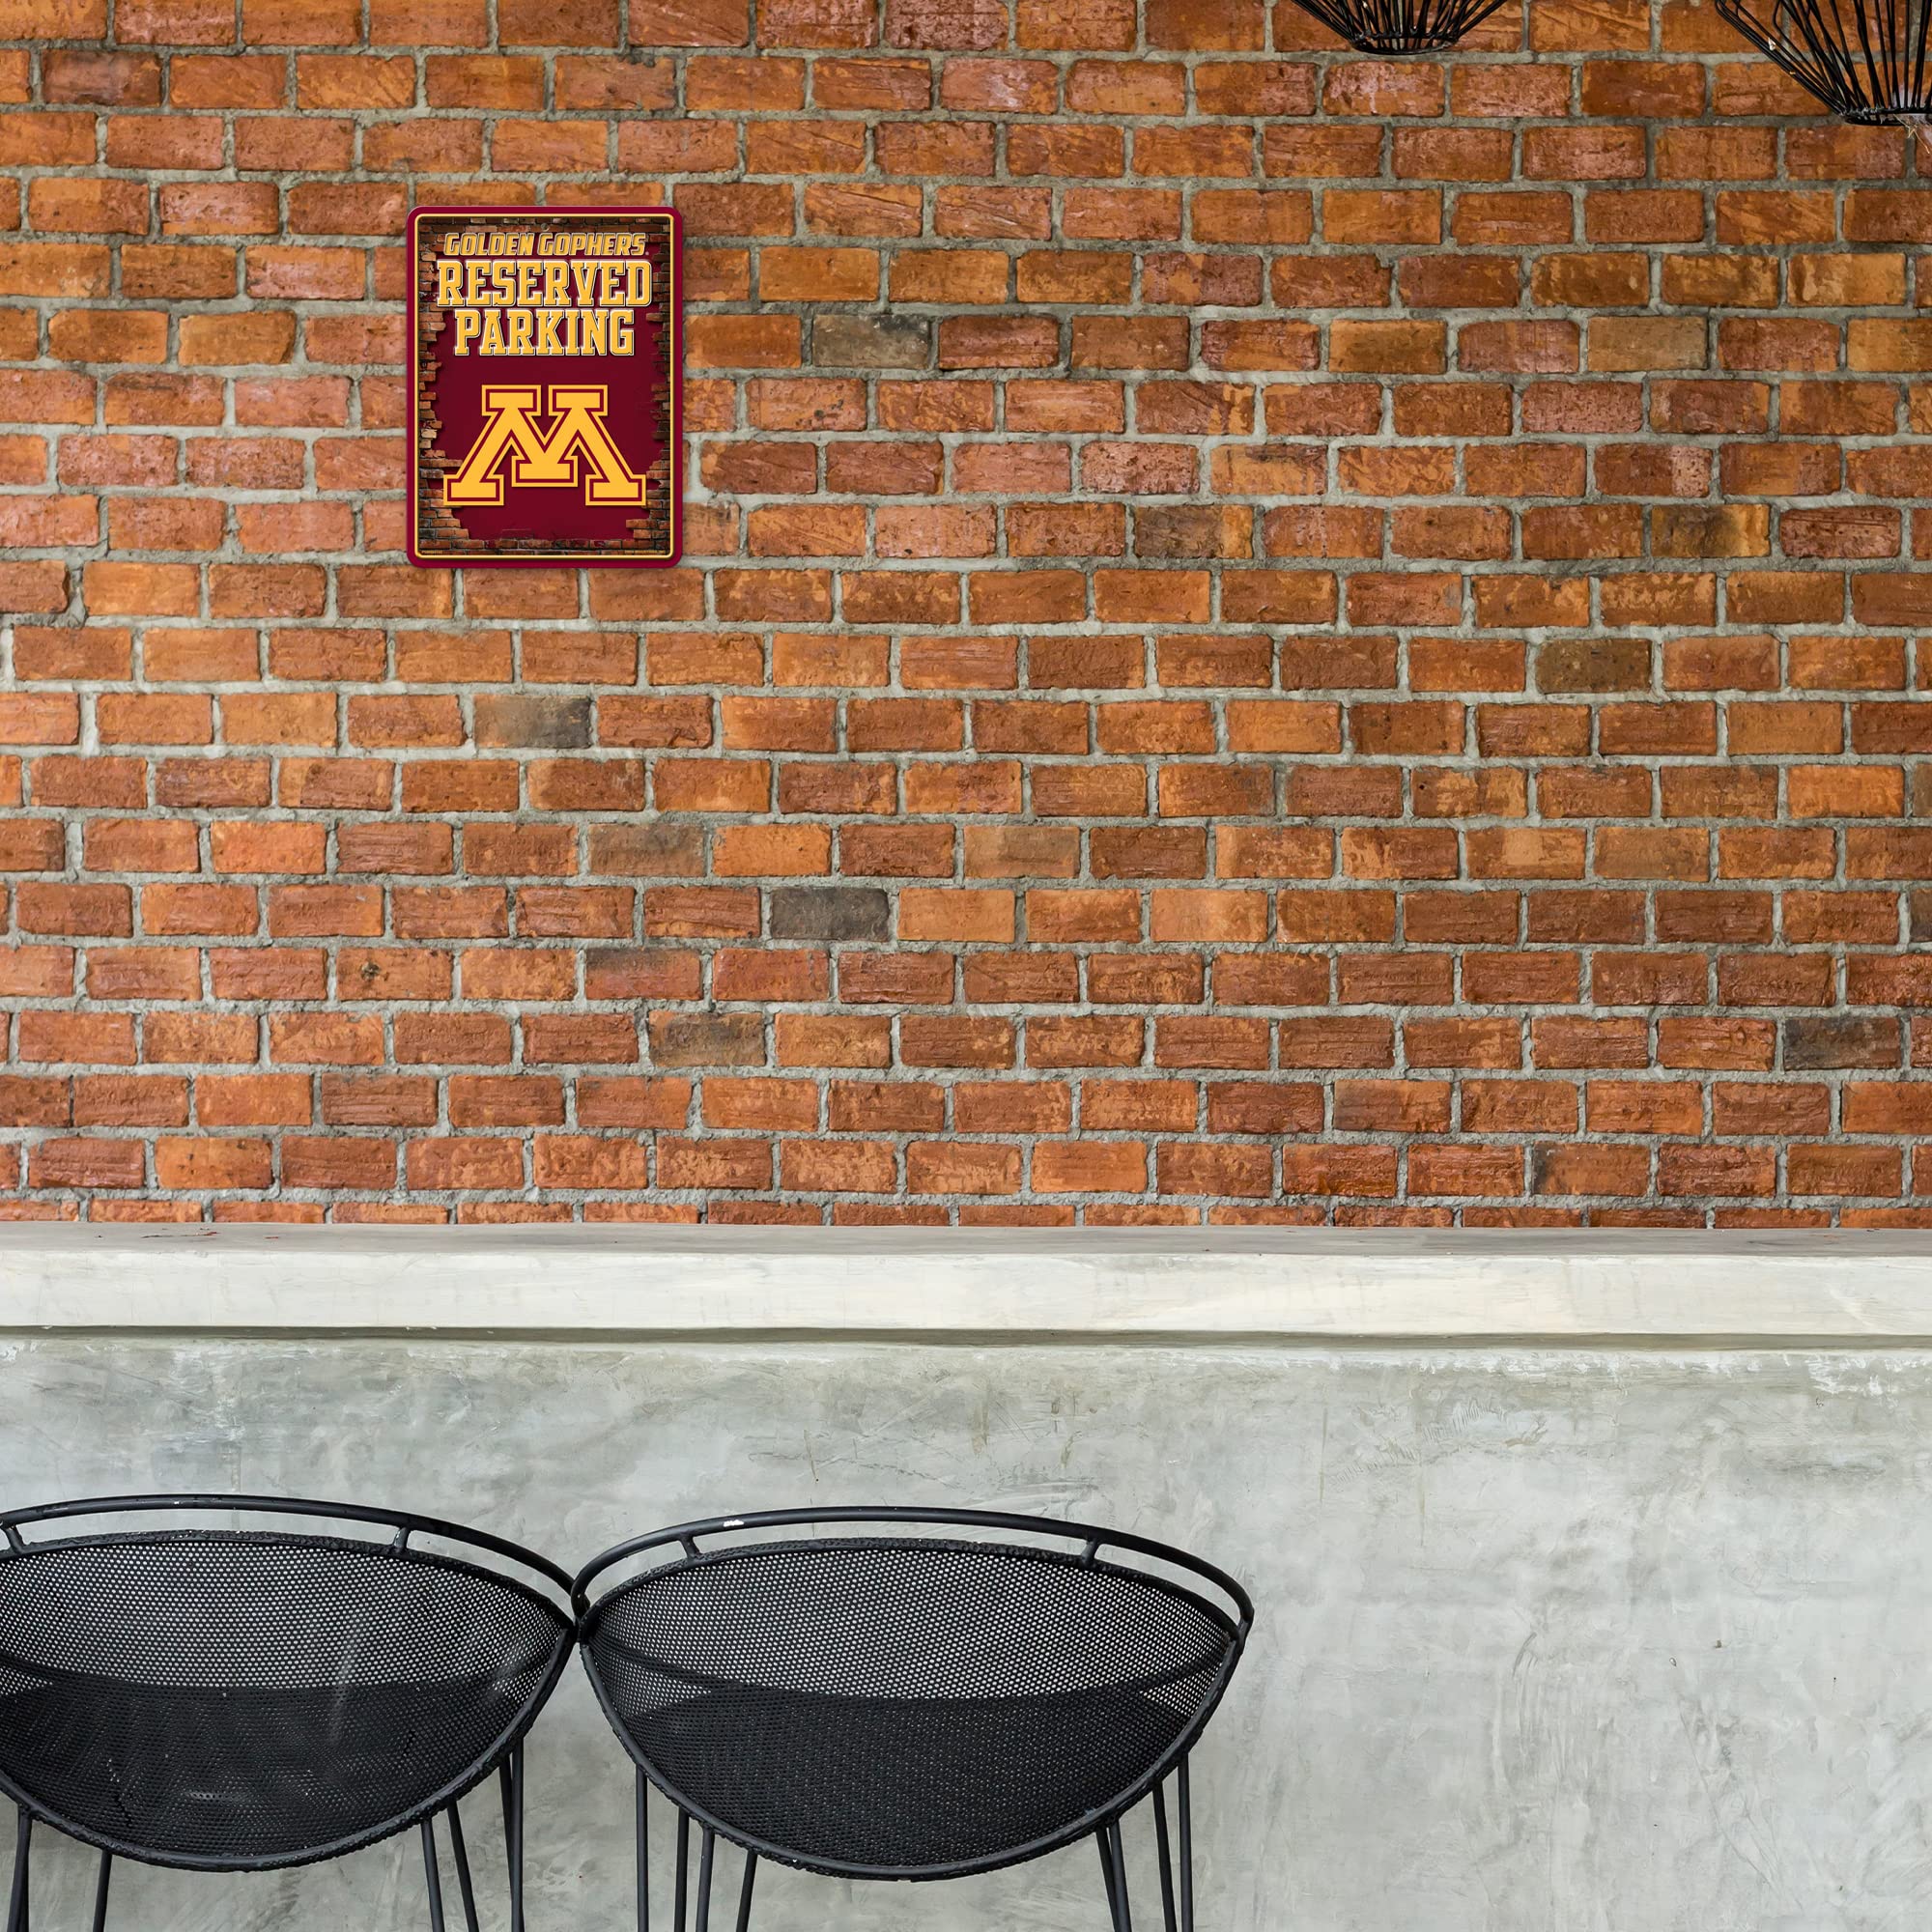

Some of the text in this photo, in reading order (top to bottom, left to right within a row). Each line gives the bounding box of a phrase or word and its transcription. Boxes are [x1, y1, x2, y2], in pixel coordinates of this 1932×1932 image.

[443, 232, 647, 256] GOLDEN GOPHERS
[437, 260, 652, 307] RESERVED
[454, 309, 635, 356] PARKING
[443, 384, 646, 506] M
